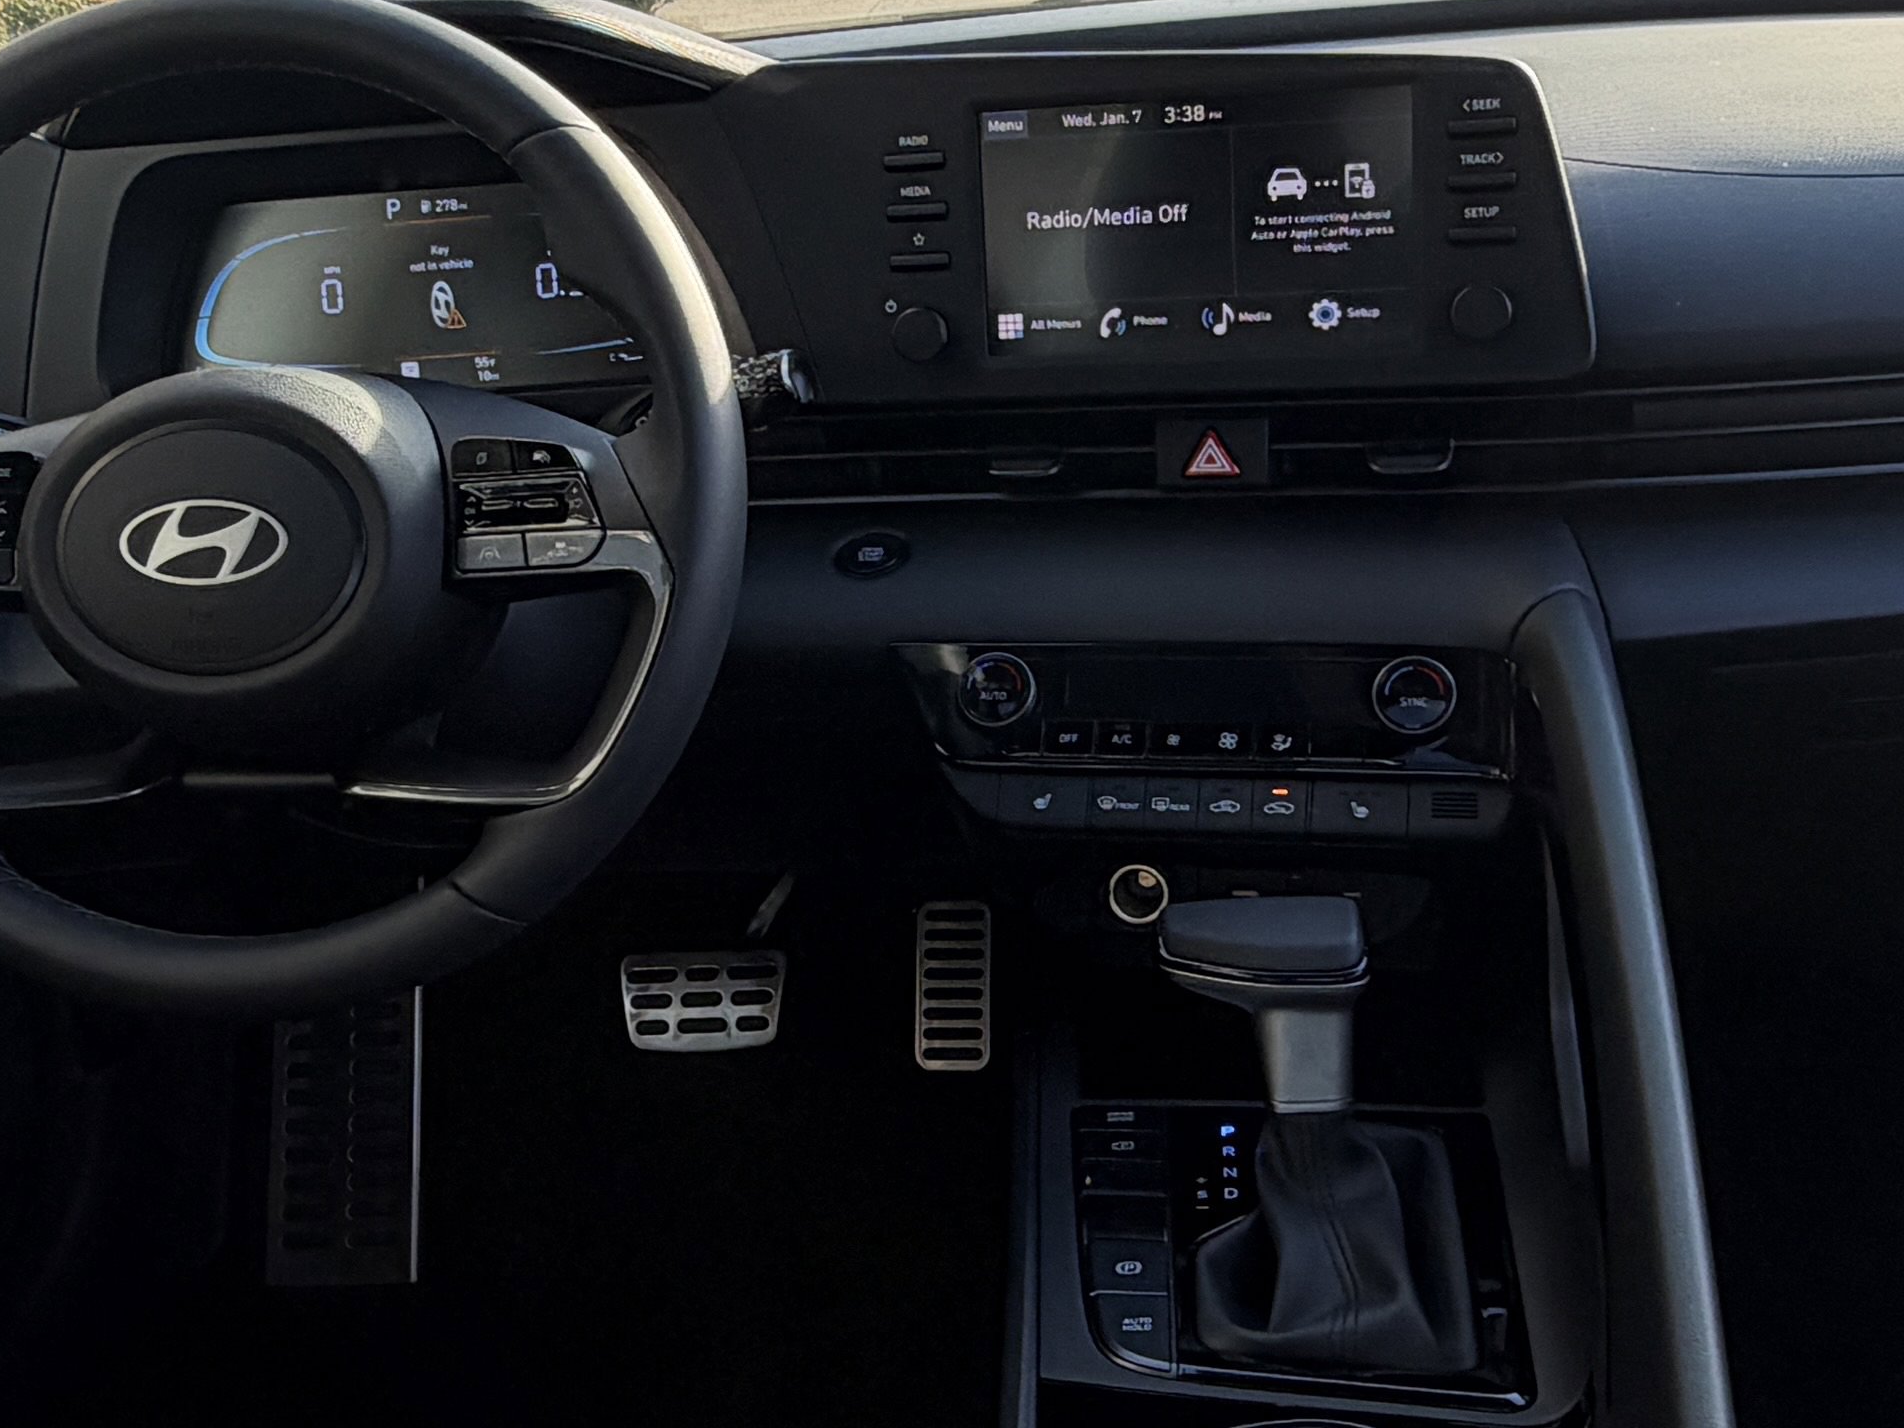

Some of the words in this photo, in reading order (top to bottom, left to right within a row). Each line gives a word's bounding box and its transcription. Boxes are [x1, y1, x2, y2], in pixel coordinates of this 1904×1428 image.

[1471, 98, 1501, 112] SEEK
[987, 120, 1024, 132] Menu
[1061, 112, 1097, 128] Wed.
[1099, 111, 1130, 127] Jan.
[1131, 109, 1143, 124] 7
[1163, 104, 1206, 124] 3:38
[898, 134, 929, 147] RADIO
[1459, 153, 1495, 165] TRACK
[899, 185, 932, 197] MEDIA
[386, 198, 401, 220] P
[1463, 205, 1501, 220] SETUP
[1025, 206, 1154, 230] Radio/Media
[1158, 203, 1189, 223] Off
[429, 244, 450, 257] Key
[409, 262, 427, 273] not
[427, 260, 438, 271] in
[438, 258, 475, 270] vehicle
[320, 278, 344, 315] 0
[1238, 311, 1272, 322] Media
[1346, 307, 1381, 319] Setup
[1030, 320, 1045, 330] All
[1046, 319, 1082, 330] Menus
[1132, 315, 1169, 326] Phone
[979, 690, 1008, 701] AUTO
[1399, 696, 1430, 708] SYNC
[1058, 733, 1079, 744] OFF
[1111, 733, 1133, 745] A/C
[1220, 1125, 1235, 1137] P
[1222, 1145, 1236, 1157] R
[1223, 1166, 1238, 1178] N
[1223, 1187, 1238, 1200] D
[1122, 1316, 1153, 1324] AUTO
